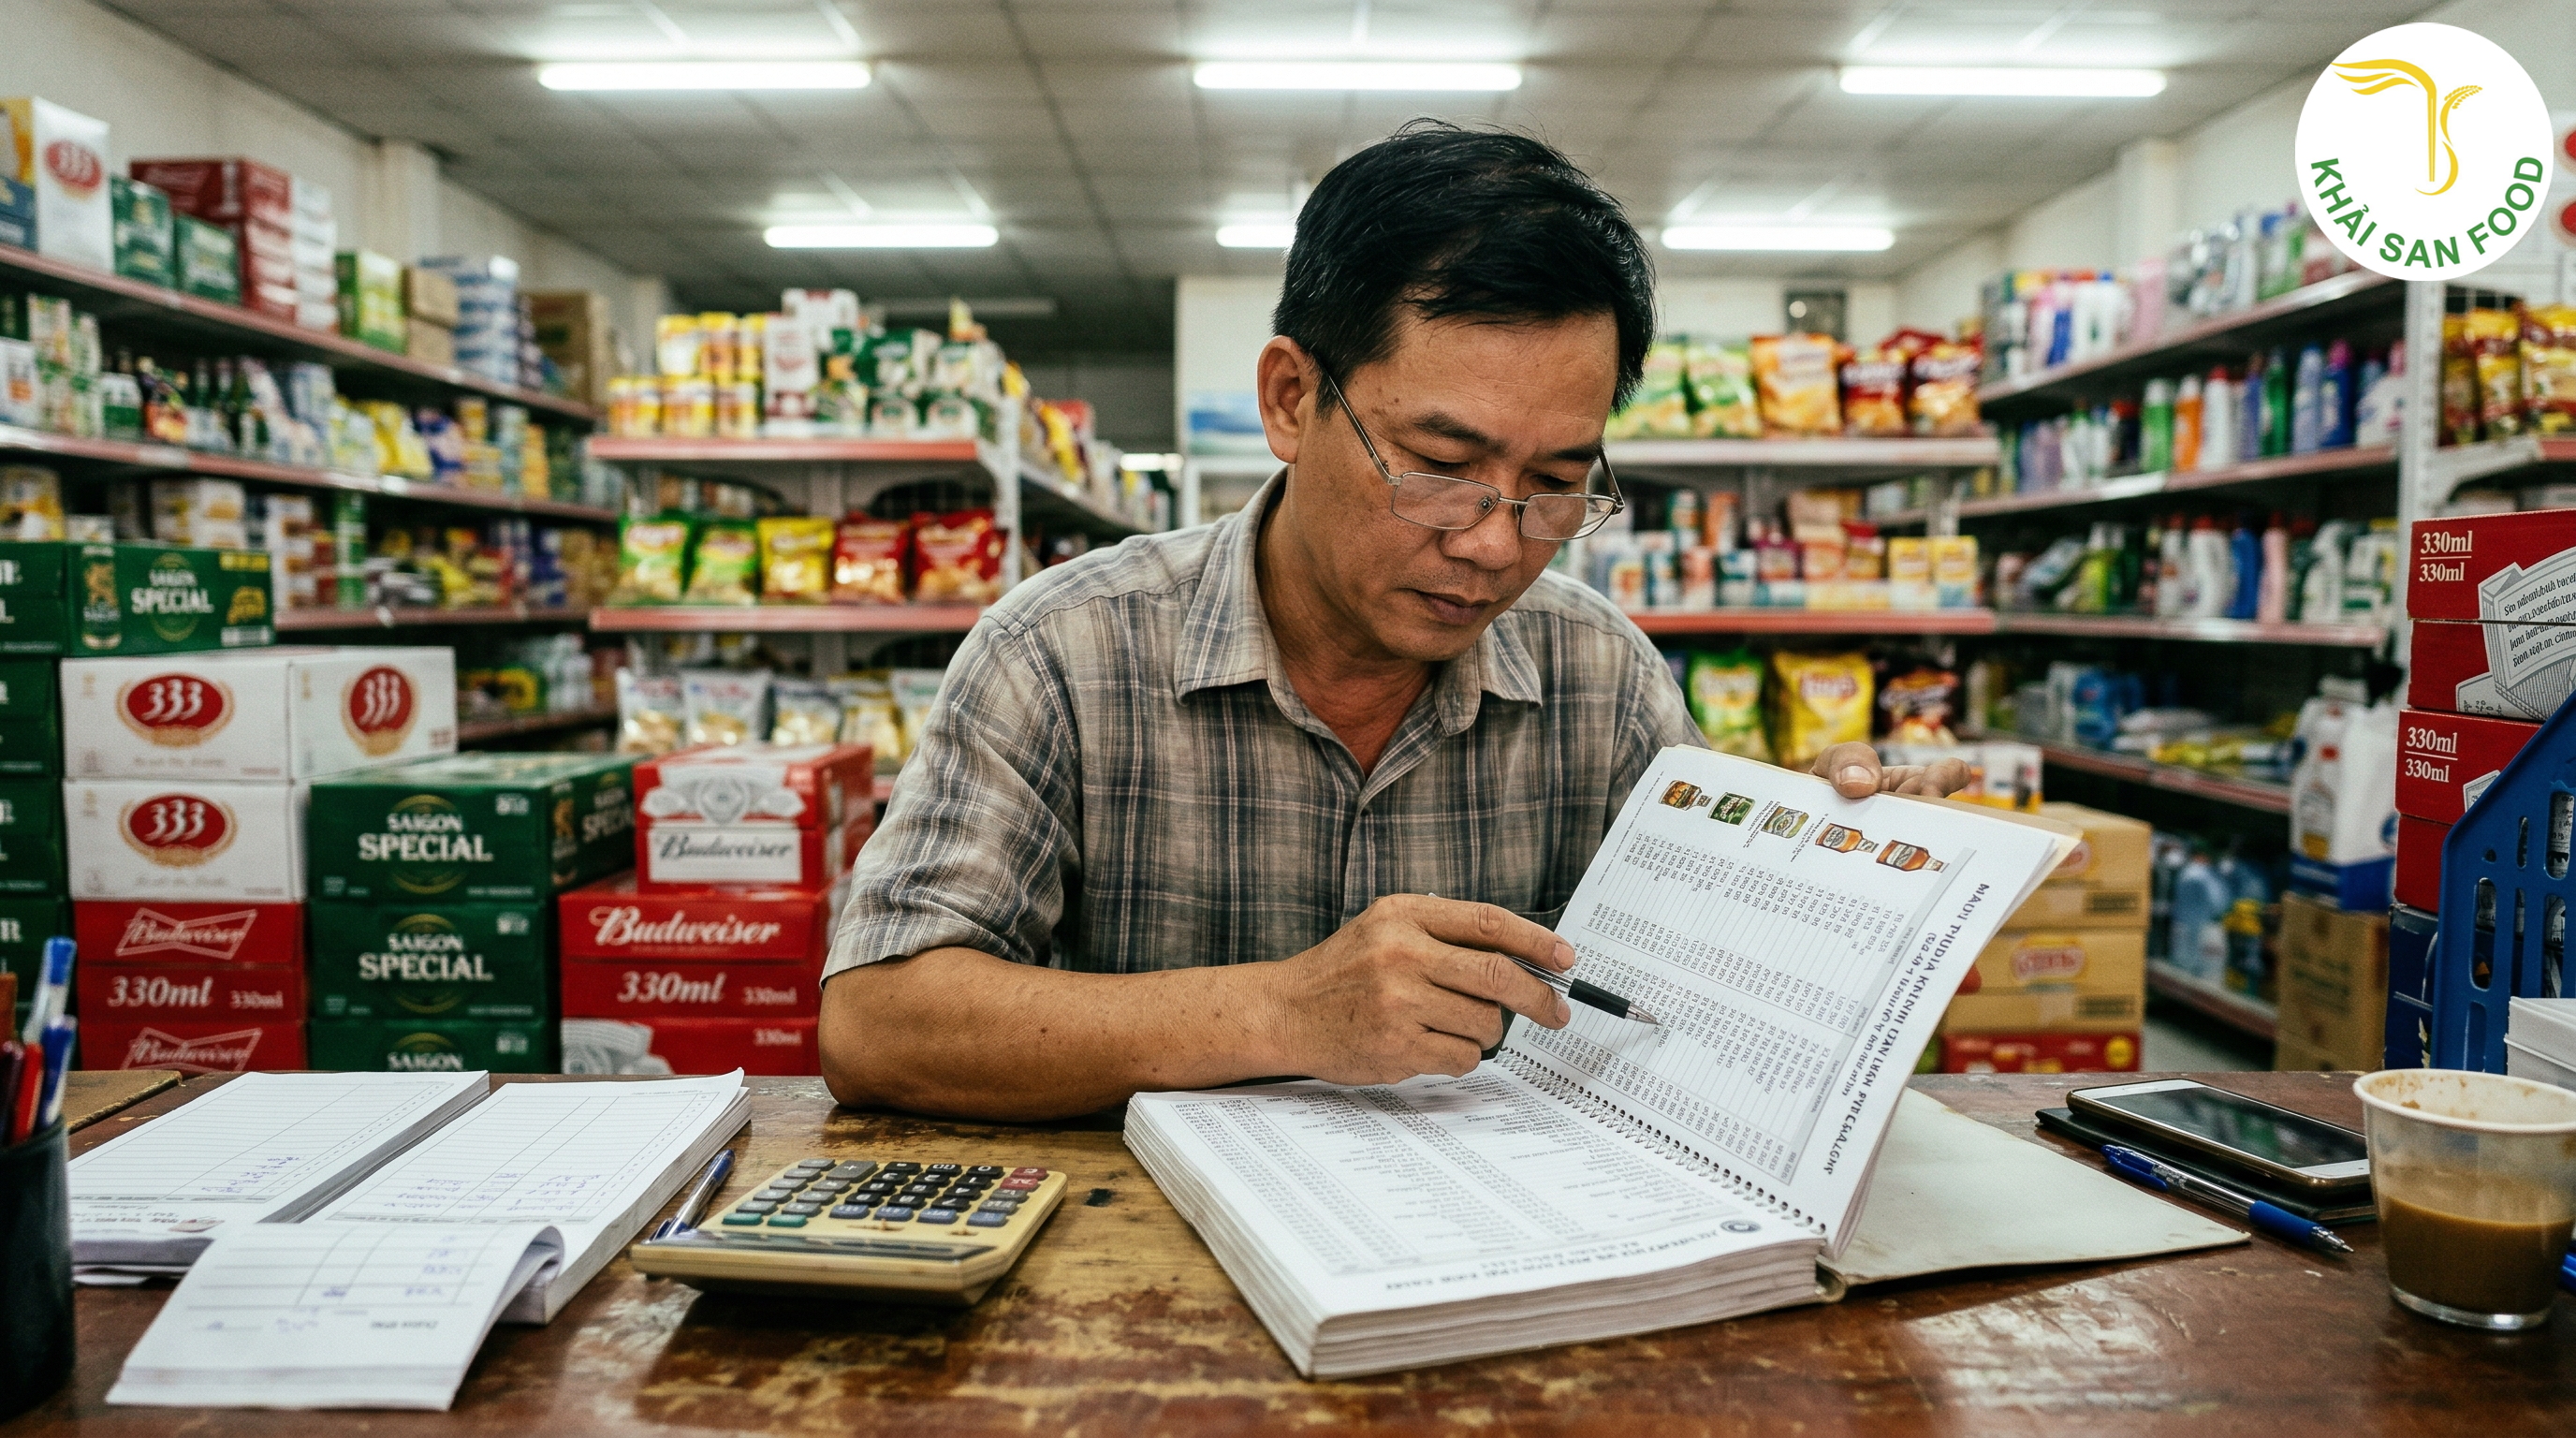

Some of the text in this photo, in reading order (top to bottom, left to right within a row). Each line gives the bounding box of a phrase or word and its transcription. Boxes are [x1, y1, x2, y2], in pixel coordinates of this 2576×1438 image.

[2420, 530, 2473, 554] 330ml
[2419, 562, 2465, 582] 330ml
[131, 587, 215, 614] SPECIAL
[141, 679, 203, 722] 333
[2406, 726, 2458, 754] 330ml
[2405, 758, 2450, 784] 330ml
[144, 799, 205, 842] 333
[387, 813, 463, 833] SAIGON
[358, 833, 494, 861] SPECIAL
[660, 835, 791, 860] Budweiser
[589, 905, 782, 946] Budweiser
[387, 932, 464, 952] SAIGON
[359, 952, 494, 981] SPECIAL
[107, 976, 213, 1007] 330ml
[617, 970, 727, 1005] 330ml
[388, 1051, 463, 1071] SAIGON
